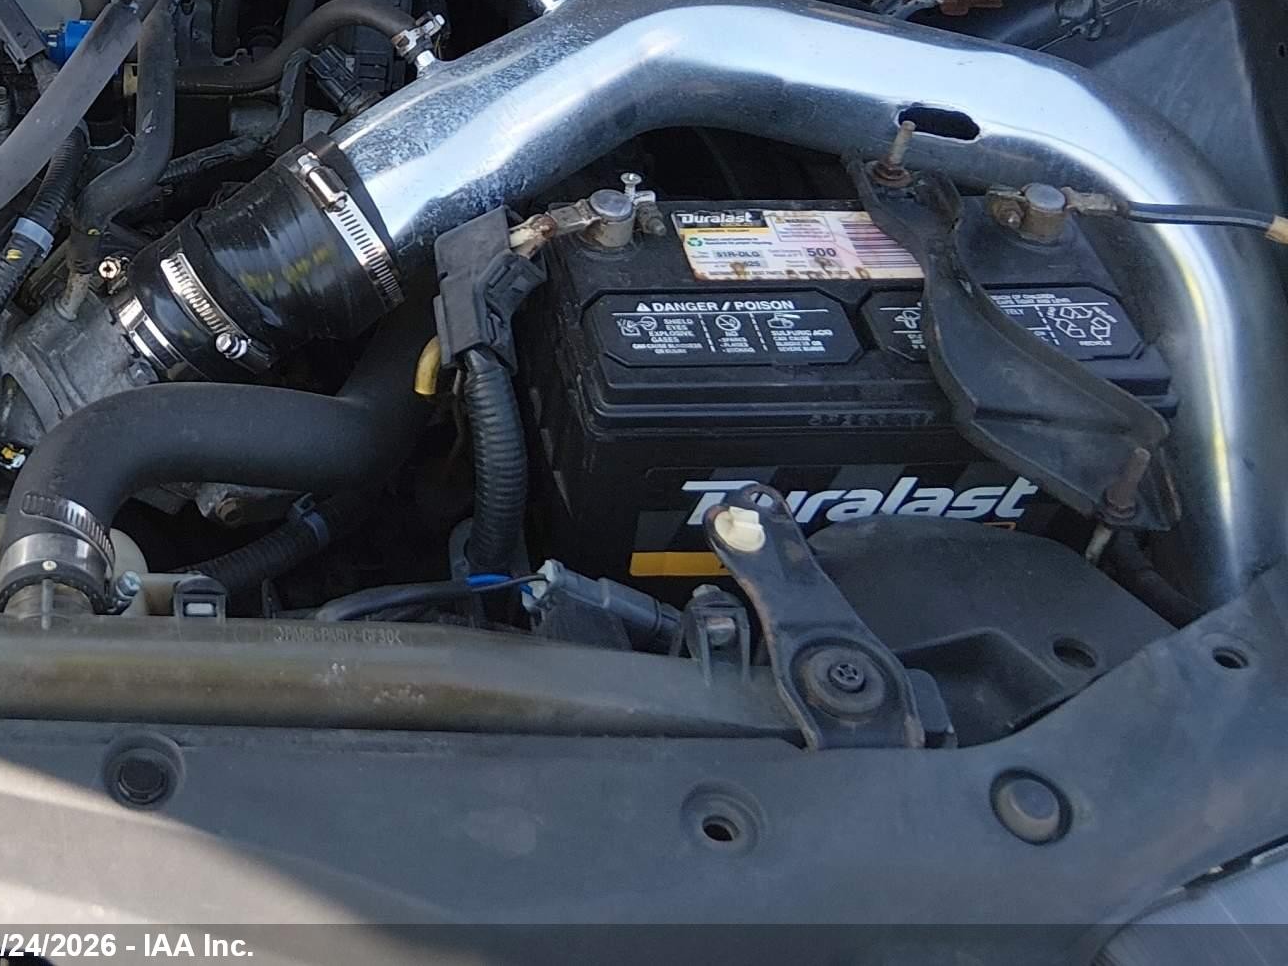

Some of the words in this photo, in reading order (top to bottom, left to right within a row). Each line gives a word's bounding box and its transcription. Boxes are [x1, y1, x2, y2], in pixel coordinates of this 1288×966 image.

[676, 211, 753, 224] Duralast
[807, 247, 837, 258] 500
[651, 301, 720, 312] DANGER
[733, 300, 795, 311] POISON
